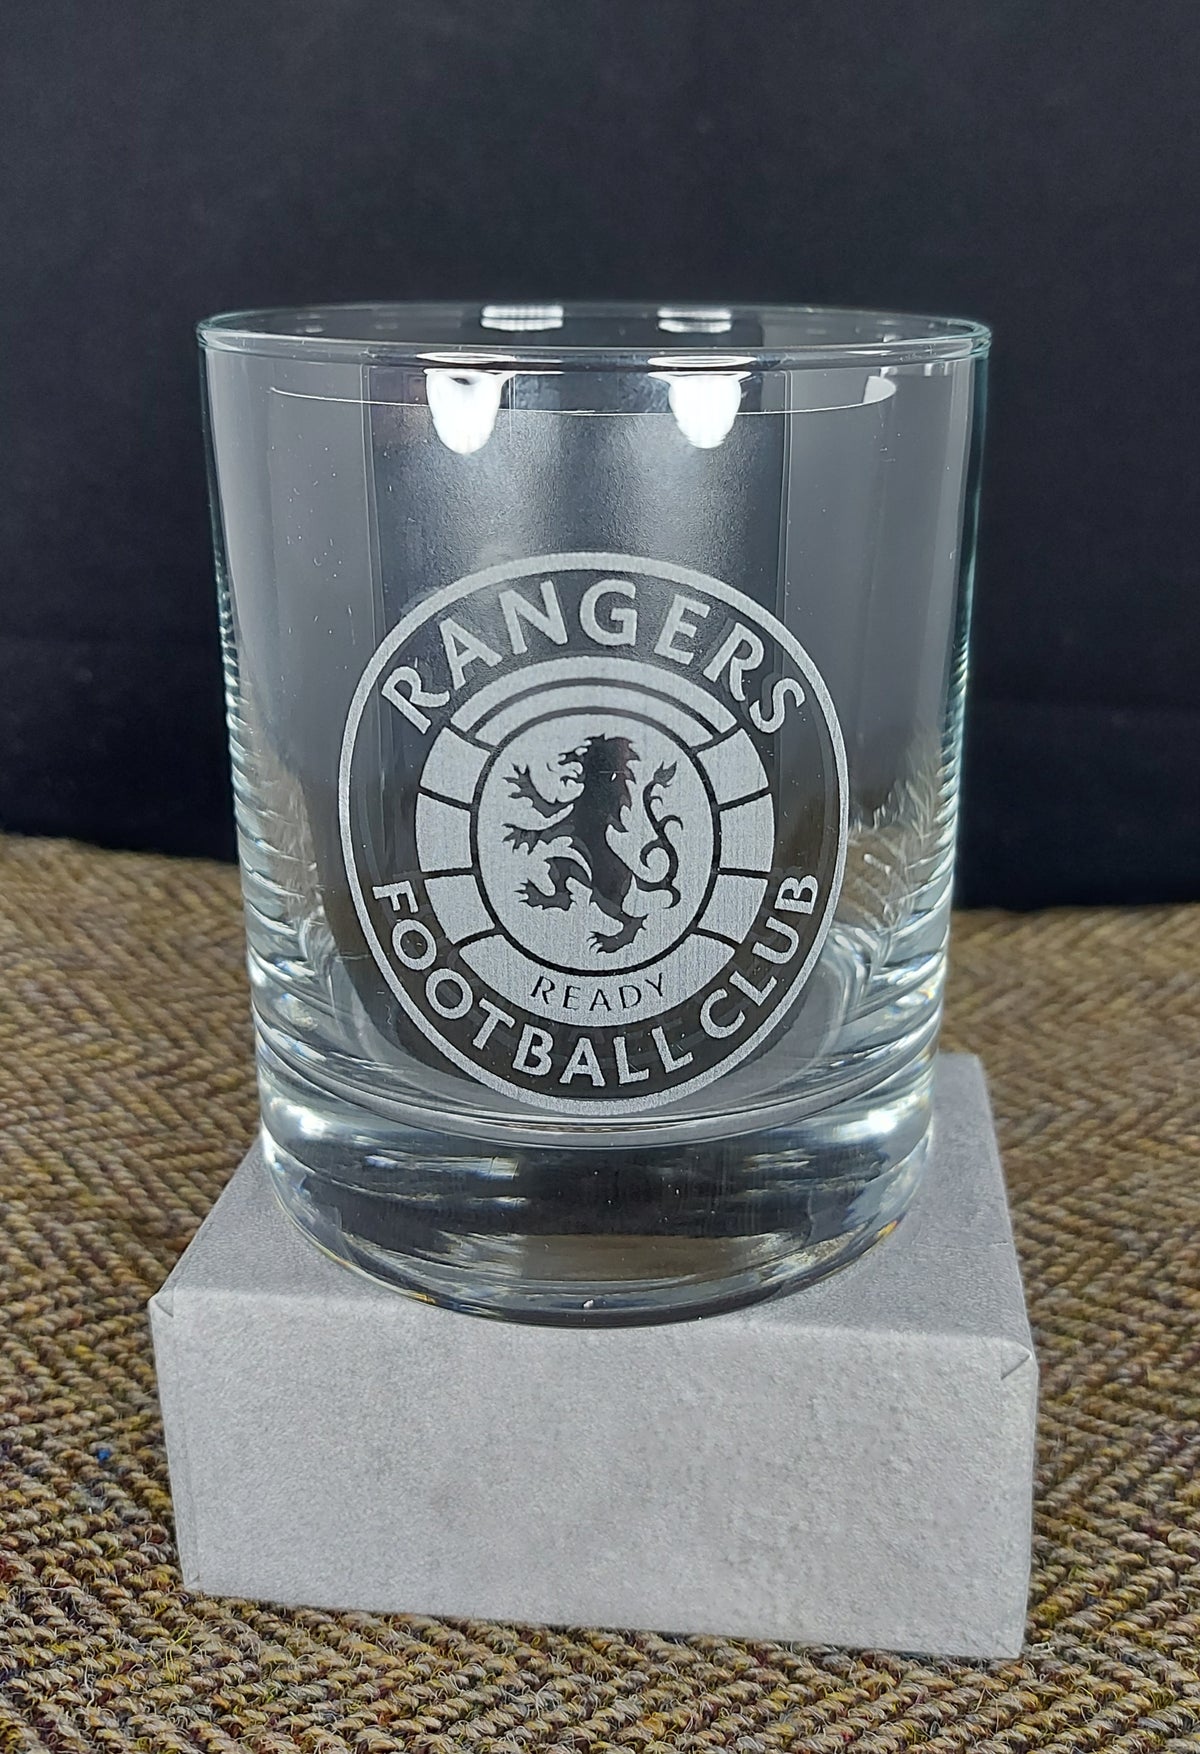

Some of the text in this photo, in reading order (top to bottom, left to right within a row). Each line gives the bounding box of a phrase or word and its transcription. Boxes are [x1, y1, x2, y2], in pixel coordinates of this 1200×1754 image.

[381, 578, 806, 734] RANGERS
[372, 873, 819, 1087] FOOTBALL CLUB
[530, 972, 665, 1012] READY
